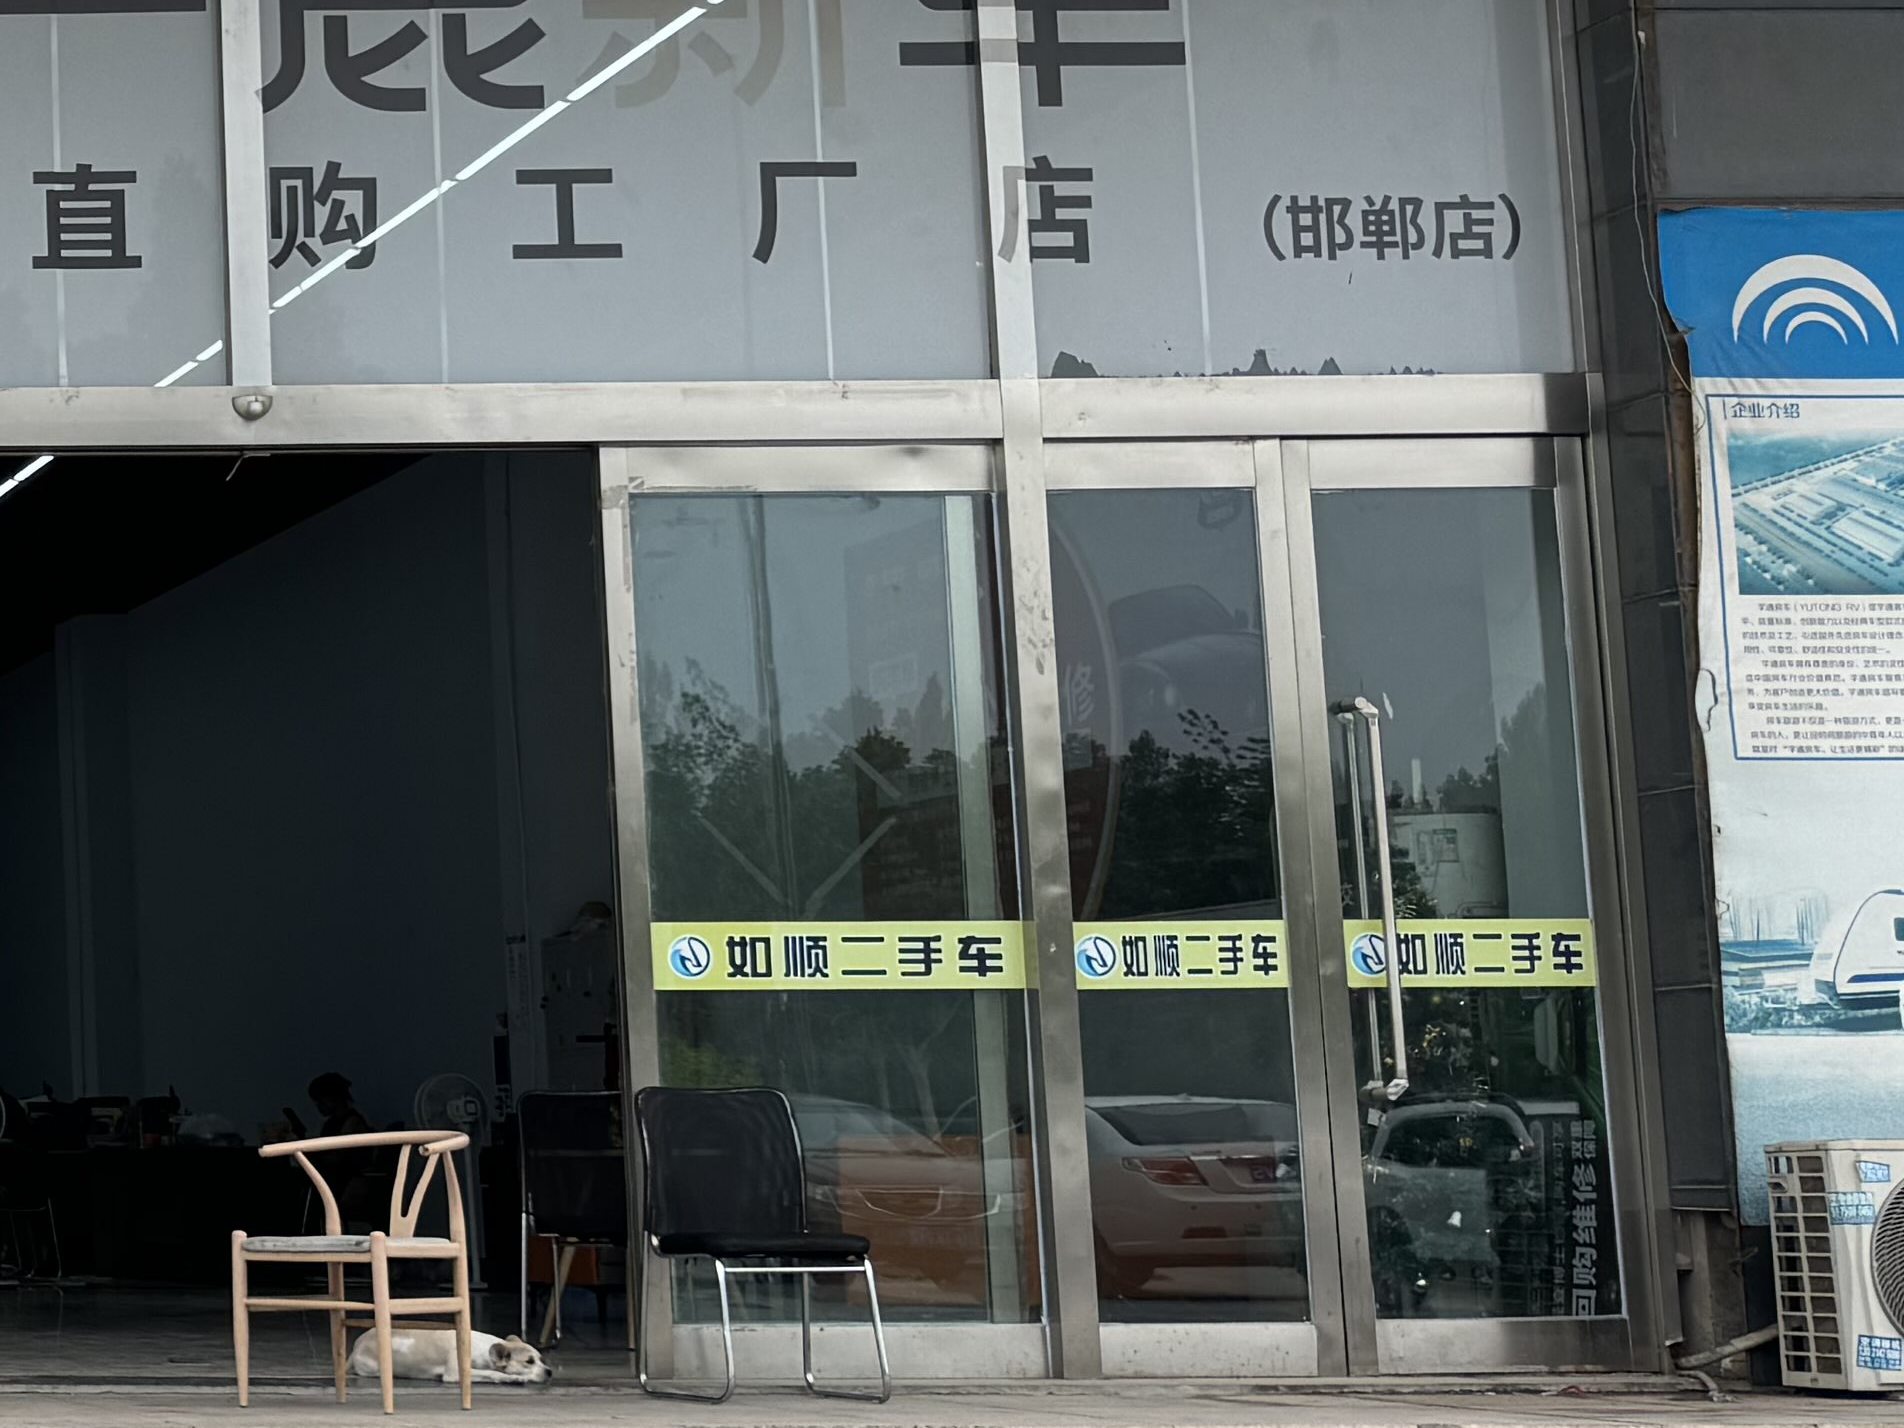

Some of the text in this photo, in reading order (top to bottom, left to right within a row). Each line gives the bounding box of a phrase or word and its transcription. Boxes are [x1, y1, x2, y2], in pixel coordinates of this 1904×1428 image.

[31, 155, 1094, 271] 直购工厂店
[1730, 402, 1801, 419] 企业介绍
[724, 934, 1005, 980] 如顺二手车
[1120, 933, 1279, 979] 如顺二手车
[1398, 931, 1585, 977] 如顺二手车
